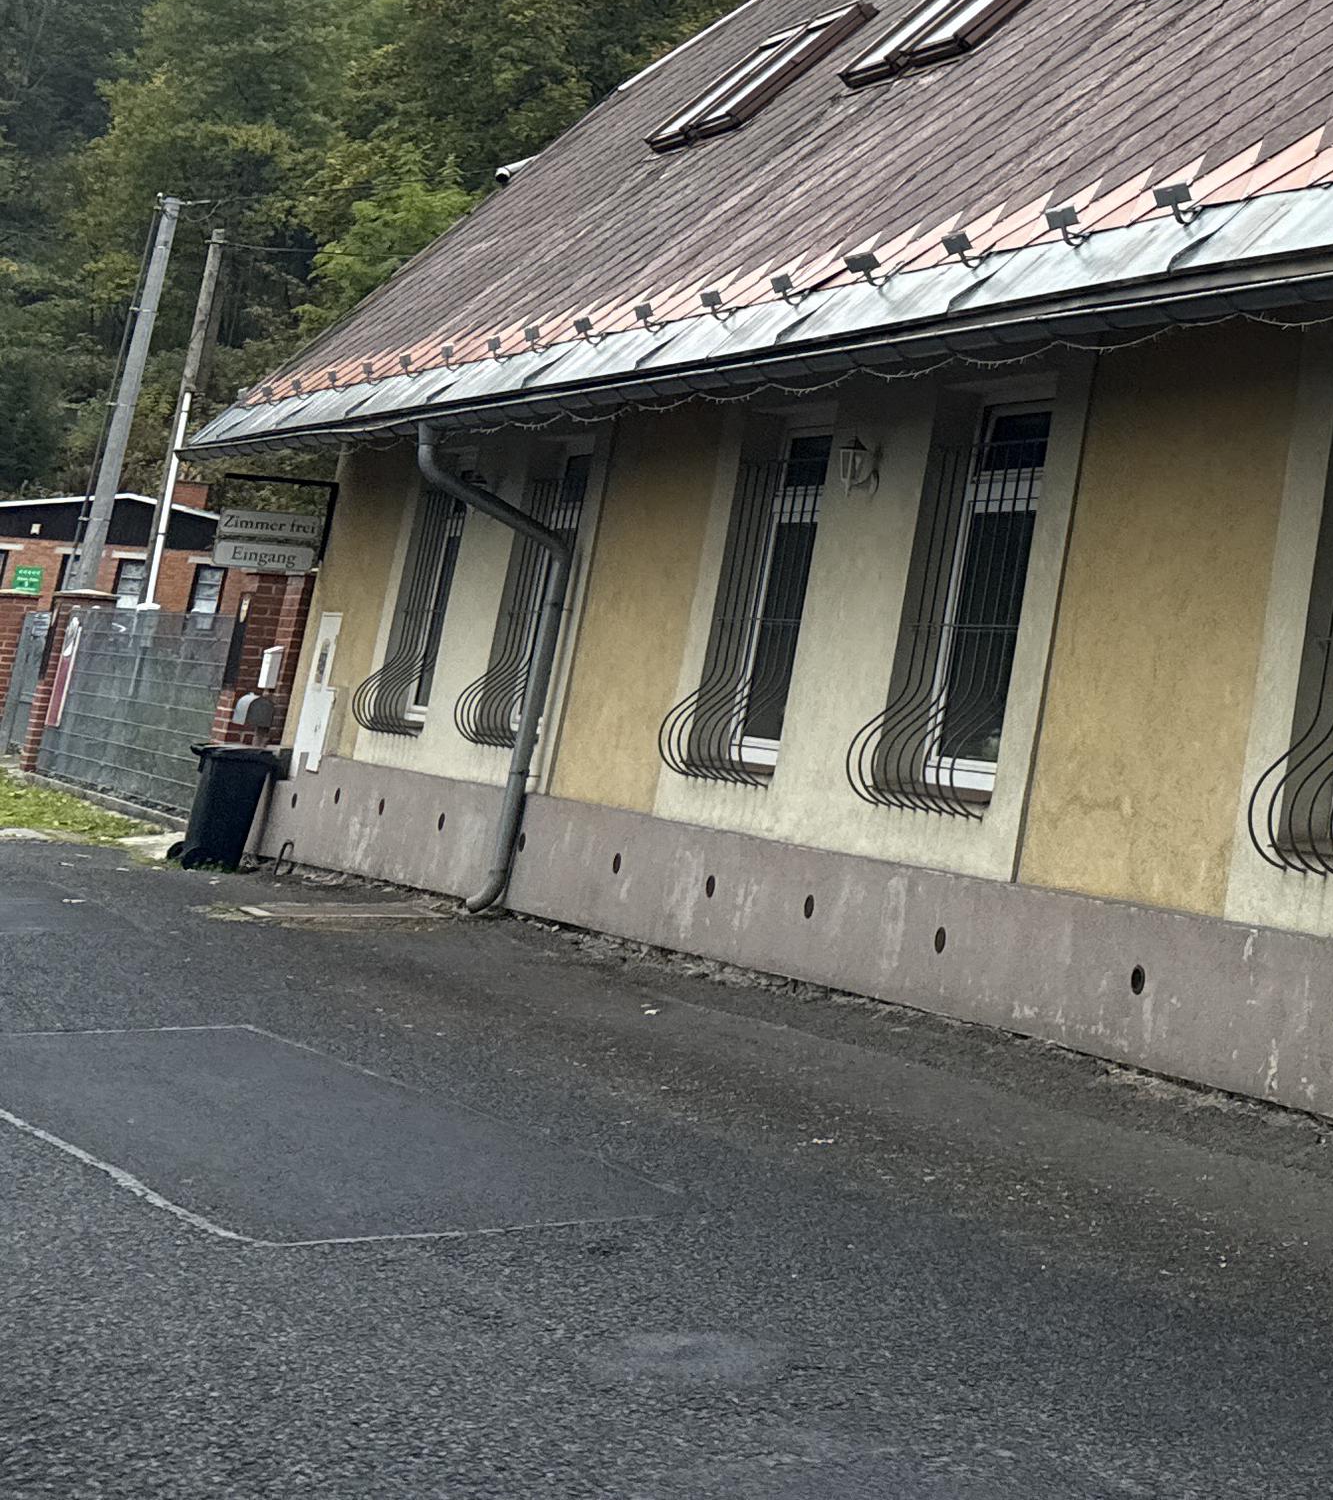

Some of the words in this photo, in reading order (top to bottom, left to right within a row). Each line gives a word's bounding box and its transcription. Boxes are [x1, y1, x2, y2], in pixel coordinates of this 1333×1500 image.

[223, 514, 287, 532] Zimmer
[289, 519, 316, 534] frei
[231, 546, 297, 569] Eingang
